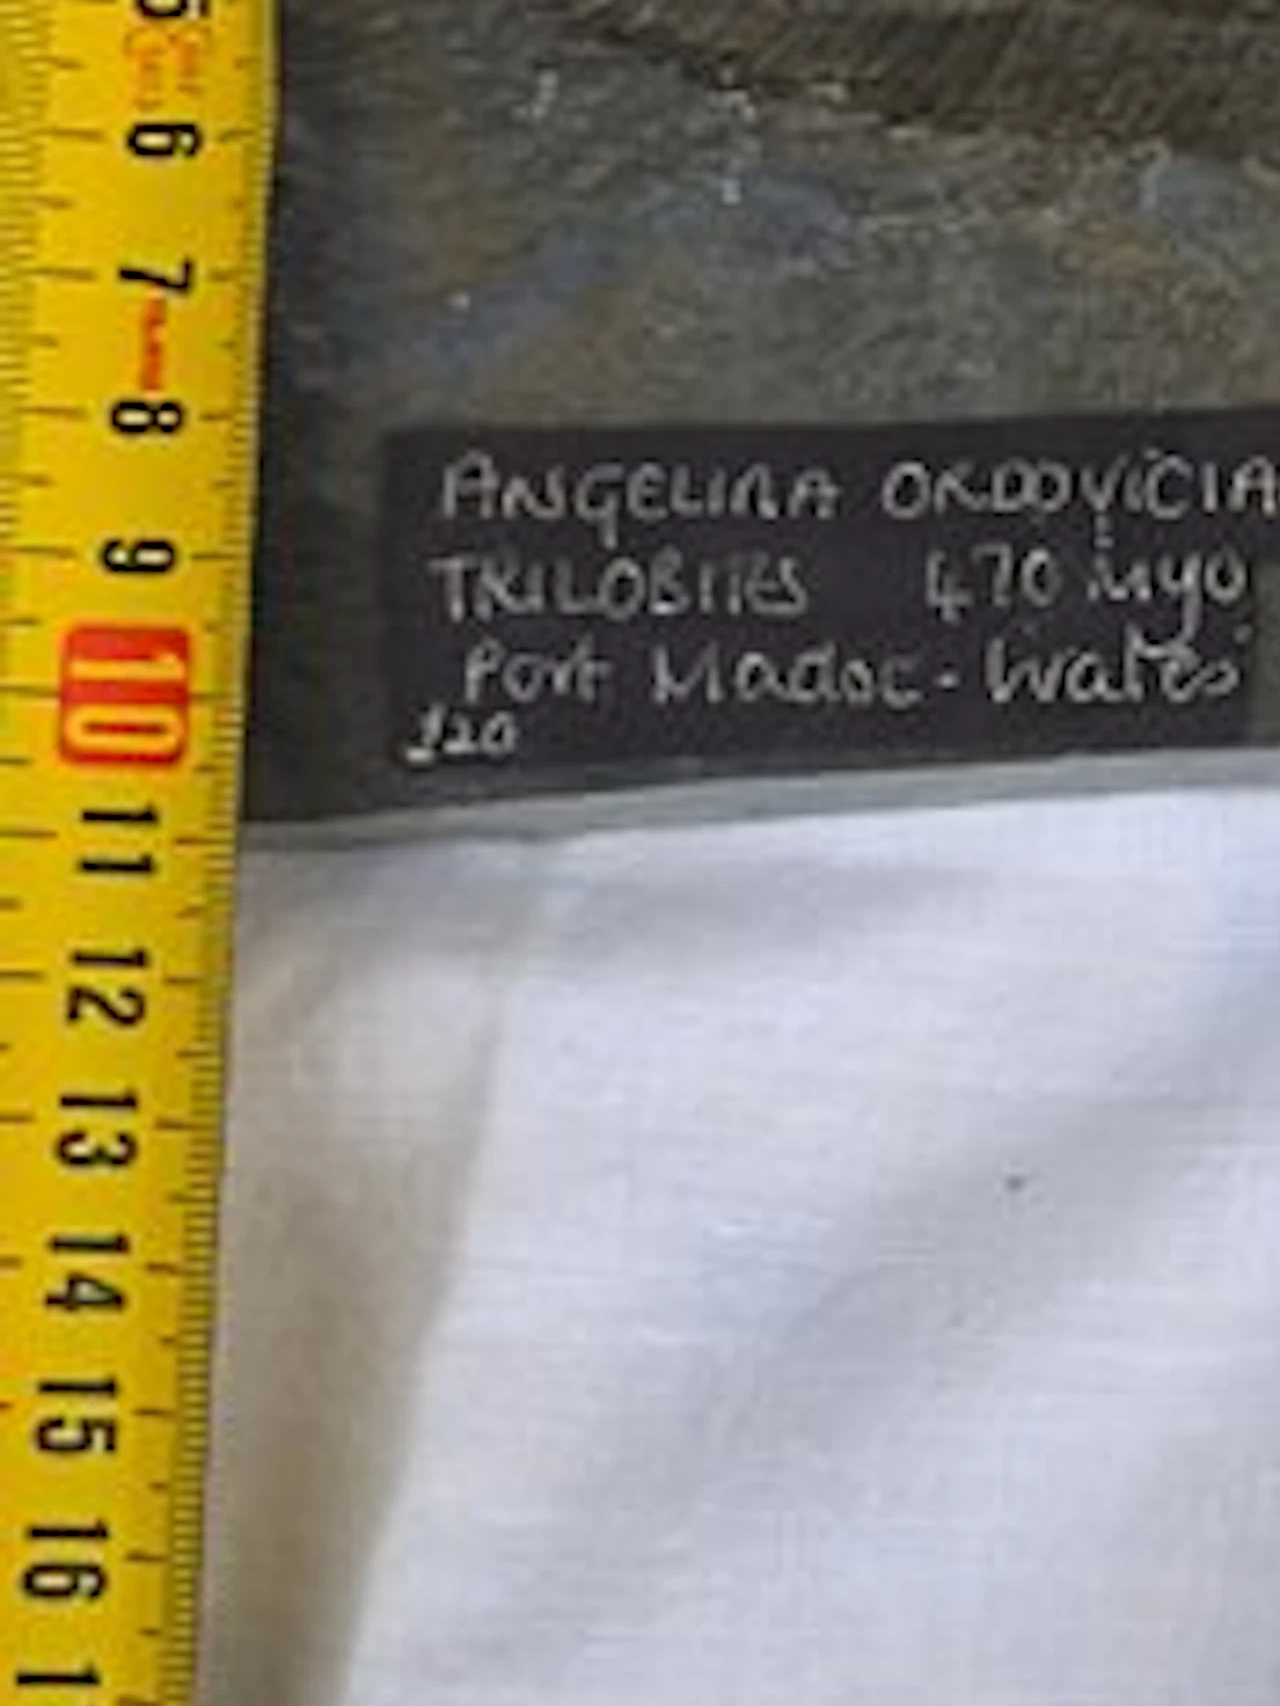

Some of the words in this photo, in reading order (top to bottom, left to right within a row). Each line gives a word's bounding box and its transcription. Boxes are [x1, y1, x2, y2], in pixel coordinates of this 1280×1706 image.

[127, 122, 203, 157] 6
[119, 259, 193, 294] 7
[111, 400, 185, 435] 8
[102, 538, 177, 575] 9
[926, 543, 1059, 621] 470
[65, 650, 188, 755] 10
[76, 802, 159, 876] 11
[66, 947, 151, 1025] 12
[54, 1089, 138, 1168] 13
[43, 1234, 131, 1312] 14
[32, 1377, 118, 1454] 15
[20, 1519, 109, 1599] 16
